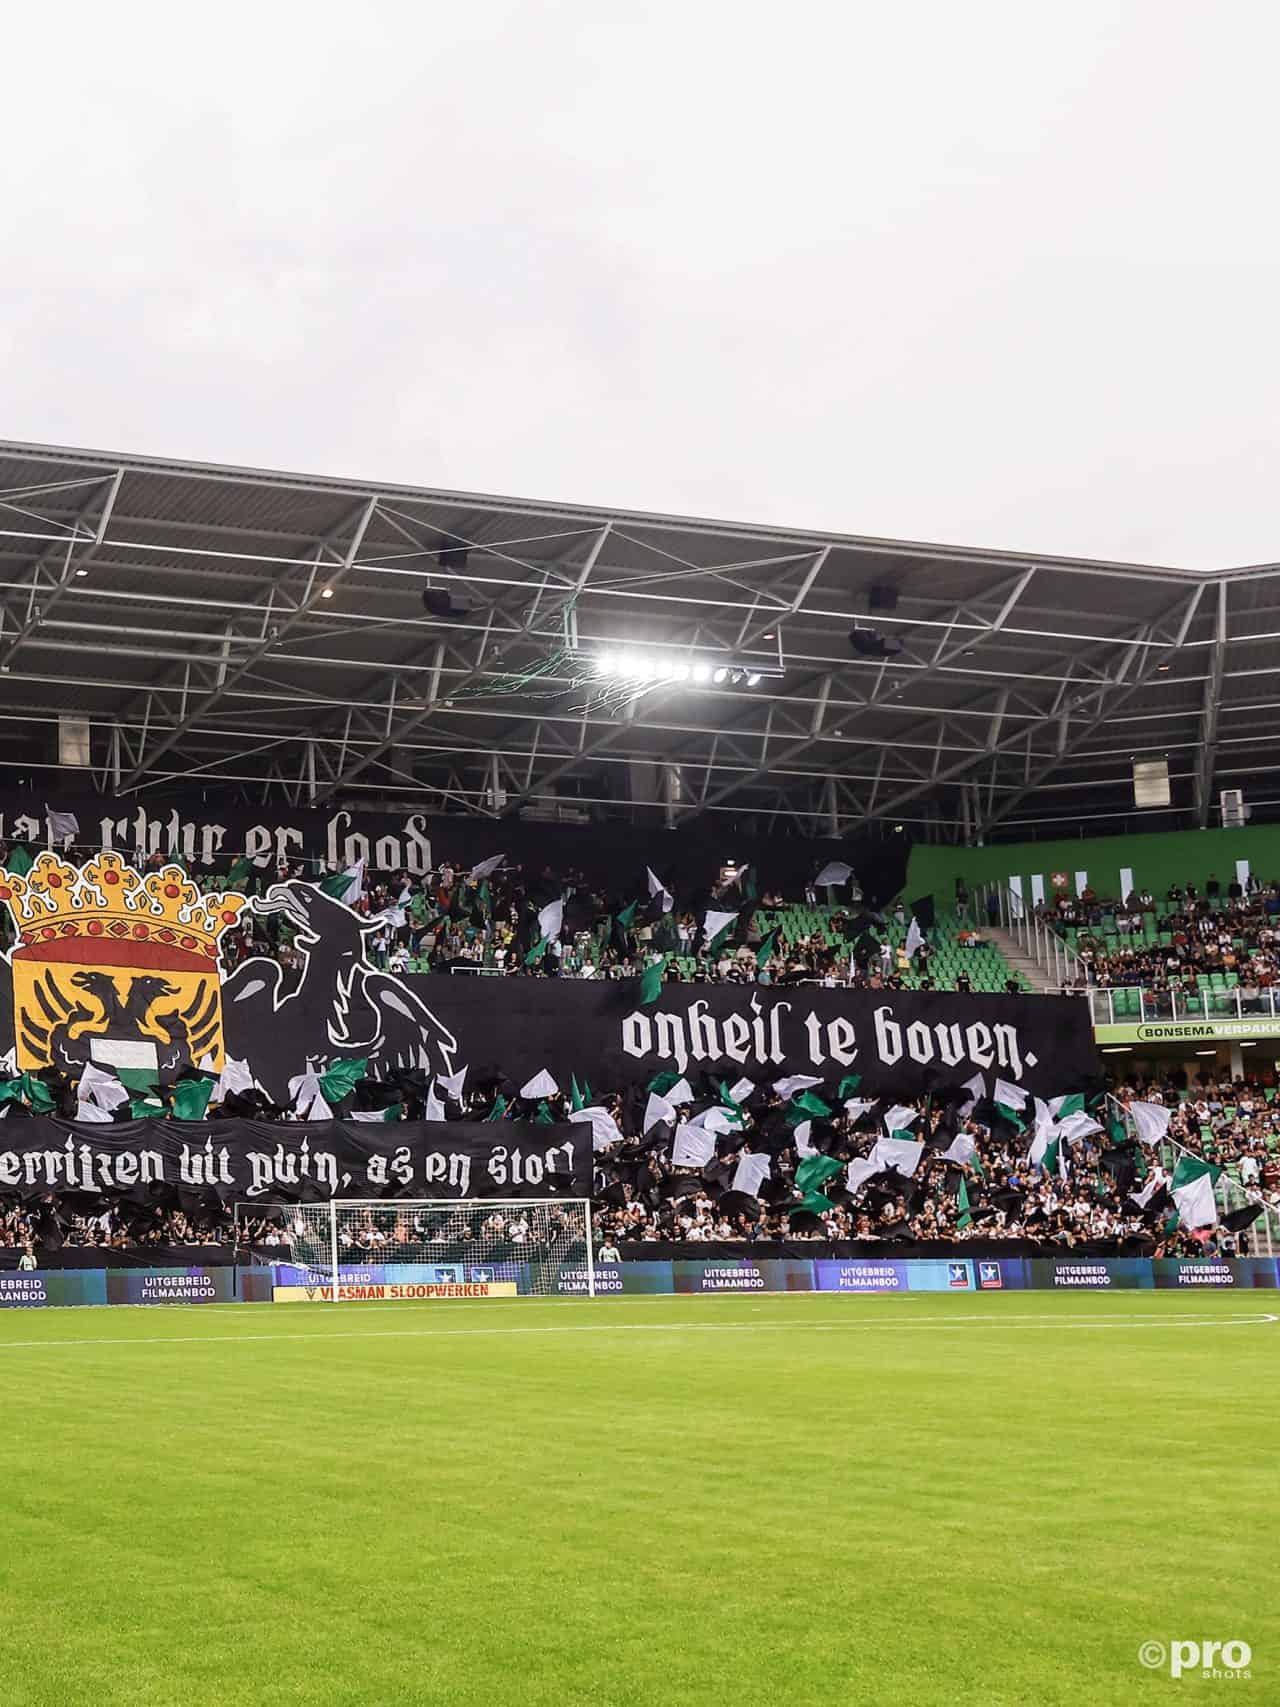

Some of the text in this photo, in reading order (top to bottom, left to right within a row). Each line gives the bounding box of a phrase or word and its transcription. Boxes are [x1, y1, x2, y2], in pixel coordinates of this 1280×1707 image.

[622, 992, 792, 1075] onheil
[805, 1009, 859, 1068] te
[873, 1006, 1039, 1081] boven.
[1145, 1026, 1214, 1038] BONSEMA
[179, 1135, 236, 1186] uit
[246, 1135, 353, 1197] puin,
[367, 1146, 415, 1185] as
[425, 1148, 471, 1197] en
[704, 1268, 760, 1278] UITGEBREID
[840, 1267, 895, 1277] UITGEBREID
[1056, 1266, 1107, 1275] UITGEBREID
[1180, 1265, 1230, 1274] UITGEBREID
[560, 1270, 619, 1281] UITGEREID
[1054, 1275, 1111, 1285] FILMAANBOD
[1178, 1274, 1234, 1284] FILMAANBOD
[145, 1276, 211, 1287] UITGEBREID
[558, 1280, 623, 1291] FILMANBOD
[702, 1277, 764, 1288] FILMAANBOD
[839, 1277, 898, 1287] FILMAANBOD
[142, 1287, 216, 1298] FILMAANBOD
[391, 1284, 489, 1299] SLOOPWERKEN
